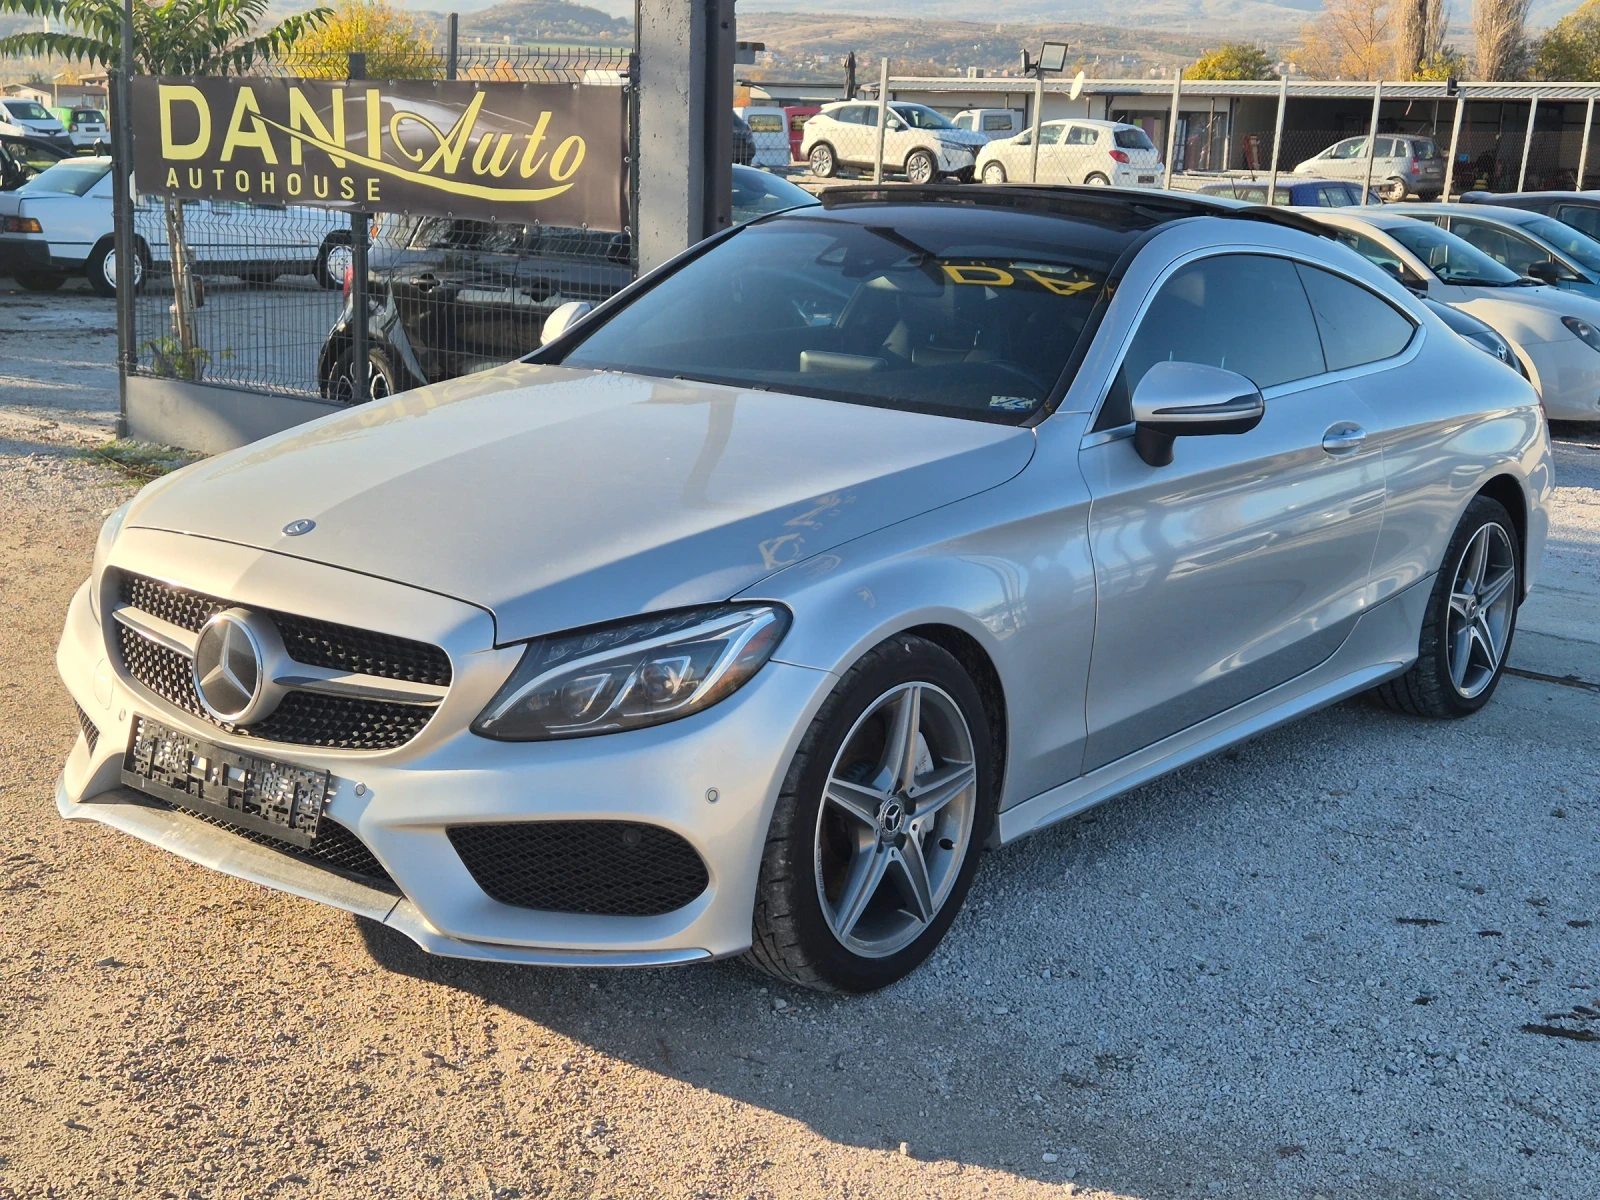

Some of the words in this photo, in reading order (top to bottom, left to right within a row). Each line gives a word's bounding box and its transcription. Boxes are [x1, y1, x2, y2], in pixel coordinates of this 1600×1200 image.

[159, 84, 382, 168] DANI
[390, 91, 586, 181] Auto
[166, 167, 381, 200] AUTOHOUSE
